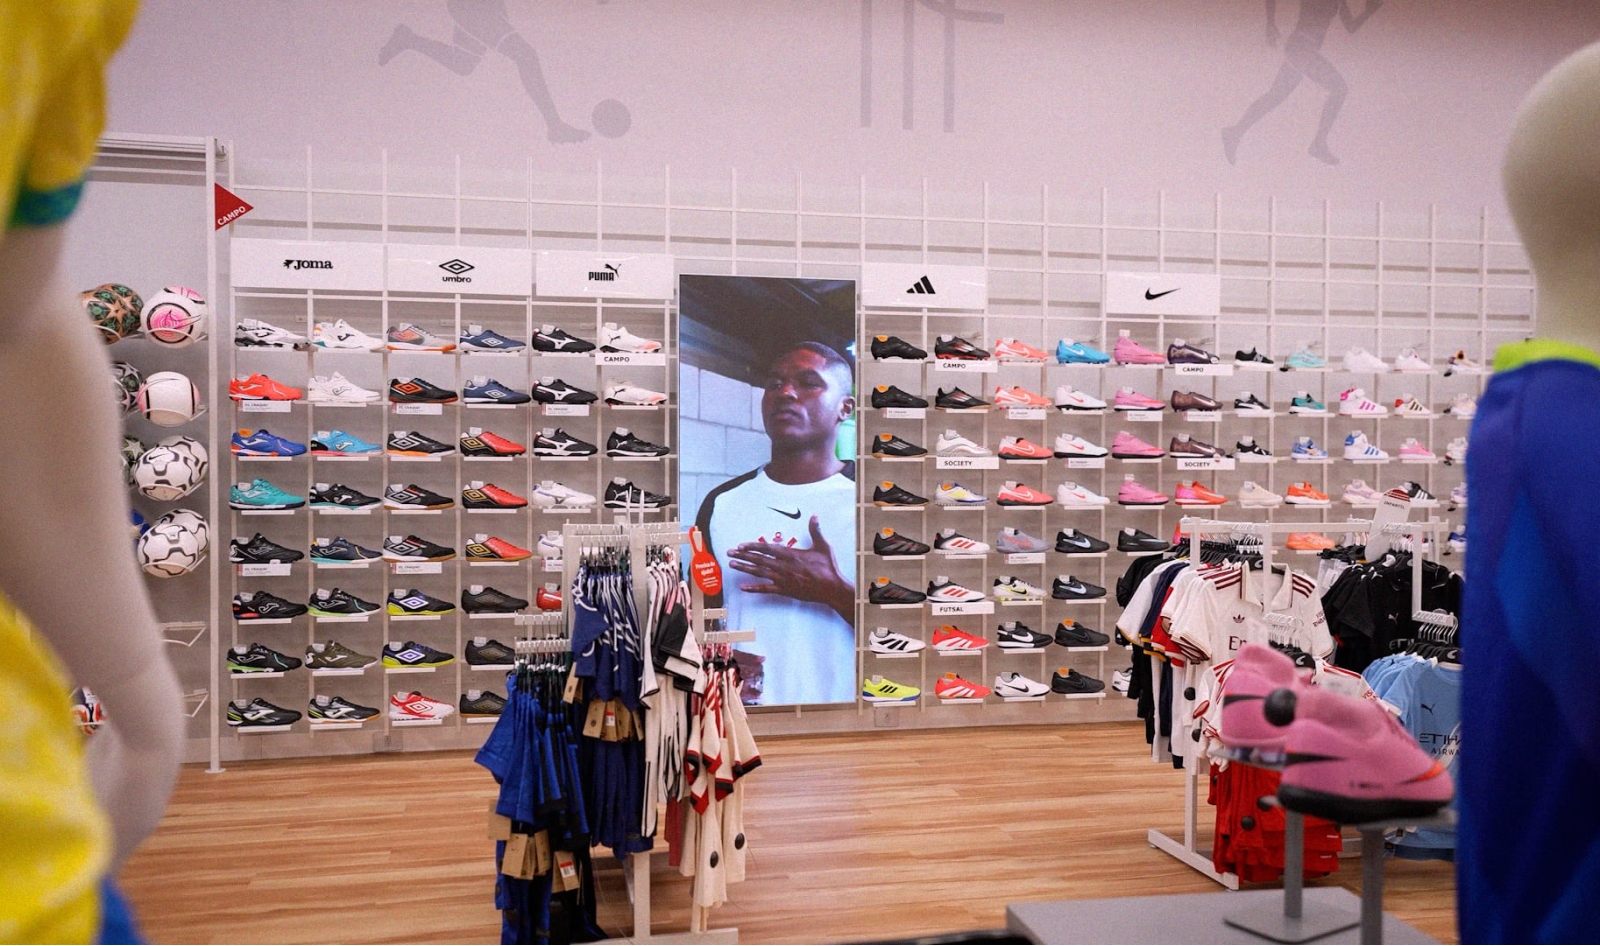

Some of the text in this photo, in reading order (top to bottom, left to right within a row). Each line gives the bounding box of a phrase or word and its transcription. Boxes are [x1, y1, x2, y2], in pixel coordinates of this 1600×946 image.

[217, 205, 246, 226] CAMPO
[442, 275, 472, 283] umbro
[588, 271, 615, 281] PUMA
